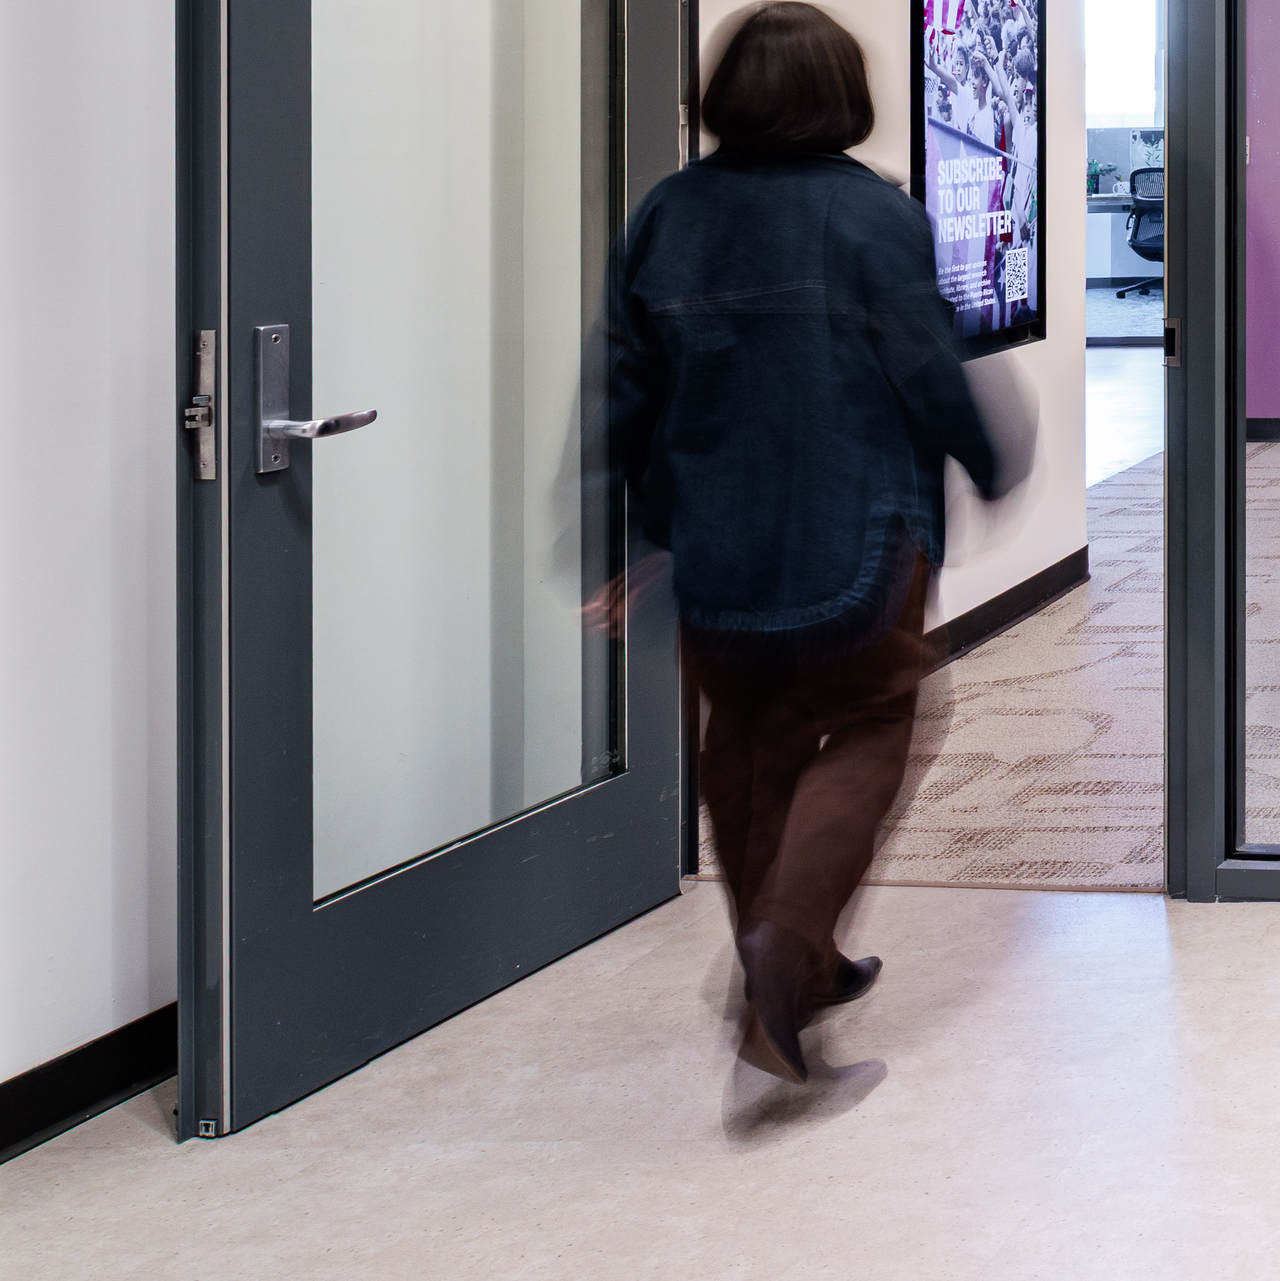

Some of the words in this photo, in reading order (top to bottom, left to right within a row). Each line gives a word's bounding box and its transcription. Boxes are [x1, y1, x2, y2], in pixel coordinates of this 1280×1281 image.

[937, 156, 1003, 187] SUBSCRIBE
[938, 188, 954, 215] TO
[956, 185, 981, 213] OUR
[938, 209, 1013, 244] NEWSLETTER
